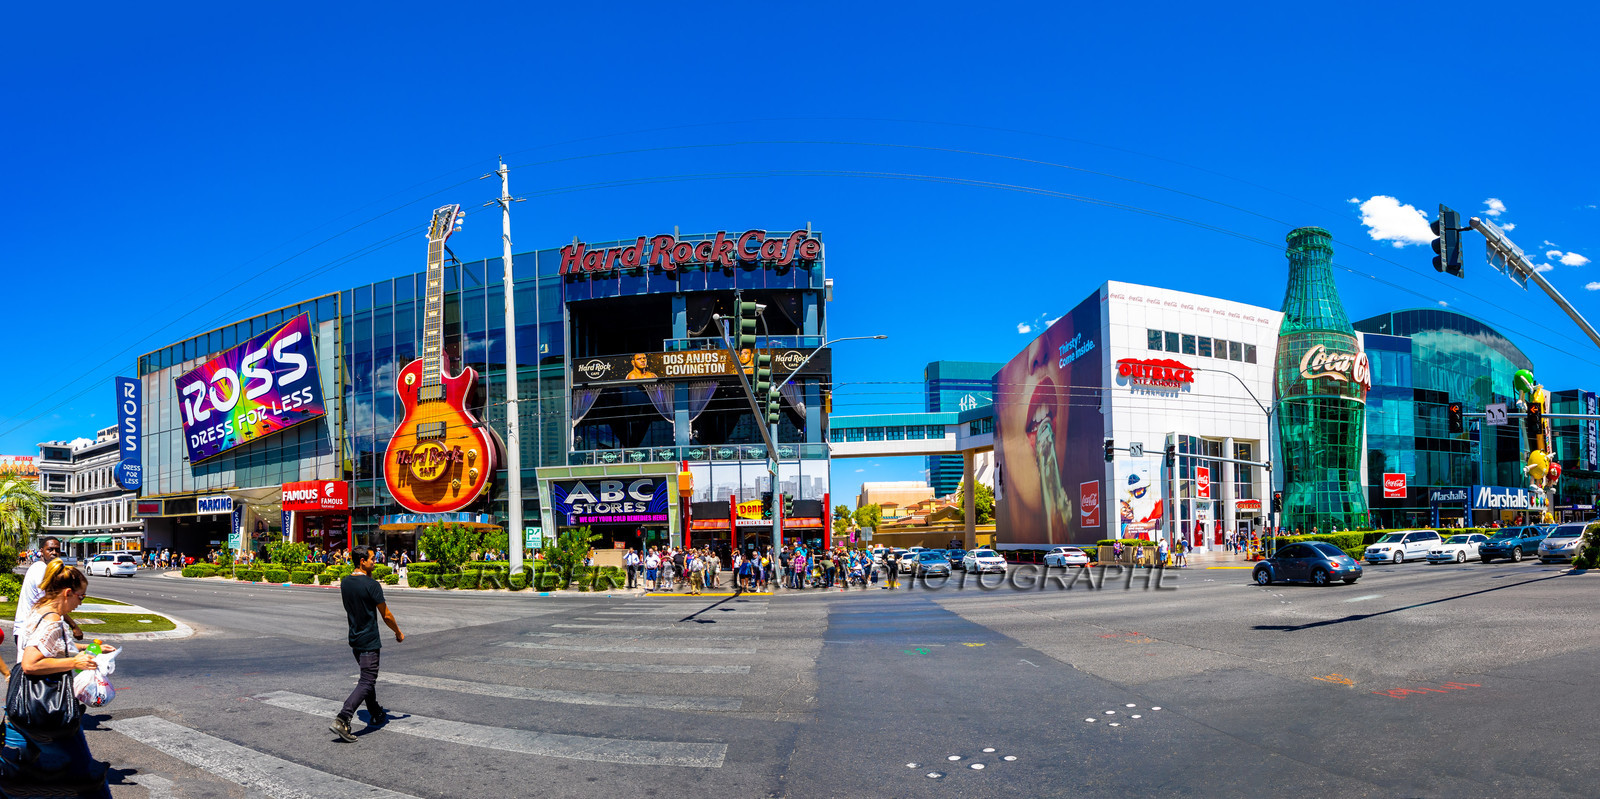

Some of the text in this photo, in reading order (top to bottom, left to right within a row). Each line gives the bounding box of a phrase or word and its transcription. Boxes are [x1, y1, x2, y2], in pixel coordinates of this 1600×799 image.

[559, 229, 821, 275] Hard Rock Cafe
[663, 353, 684, 365] DOS
[686, 352, 719, 364] ANJOS
[775, 354, 792, 362] Hard
[1058, 352, 1075, 369] Come
[578, 362, 612, 372] Hard Rock
[665, 362, 726, 376] COVINGTON
[1118, 363, 1194, 383] OUTBACK
[183, 332, 307, 426] ROSS
[1133, 378, 1182, 389] STEAKHOUSE
[124, 382, 137, 451] ROSS
[191, 386, 313, 448] DRESS FOR LESS
[396, 445, 464, 465] Hard Rock
[282, 488, 318, 501] FAMOUS
[564, 479, 654, 504] ABC
[1431, 490, 1467, 501] Marshalls
[1476, 487, 1528, 508] Marshalls
[199, 498, 232, 512] PARKING
[573, 502, 646, 514] STORES
[738, 504, 762, 514] Denn
[627, 514, 652, 522] REMEDIES
[527, 528, 535, 540] P
